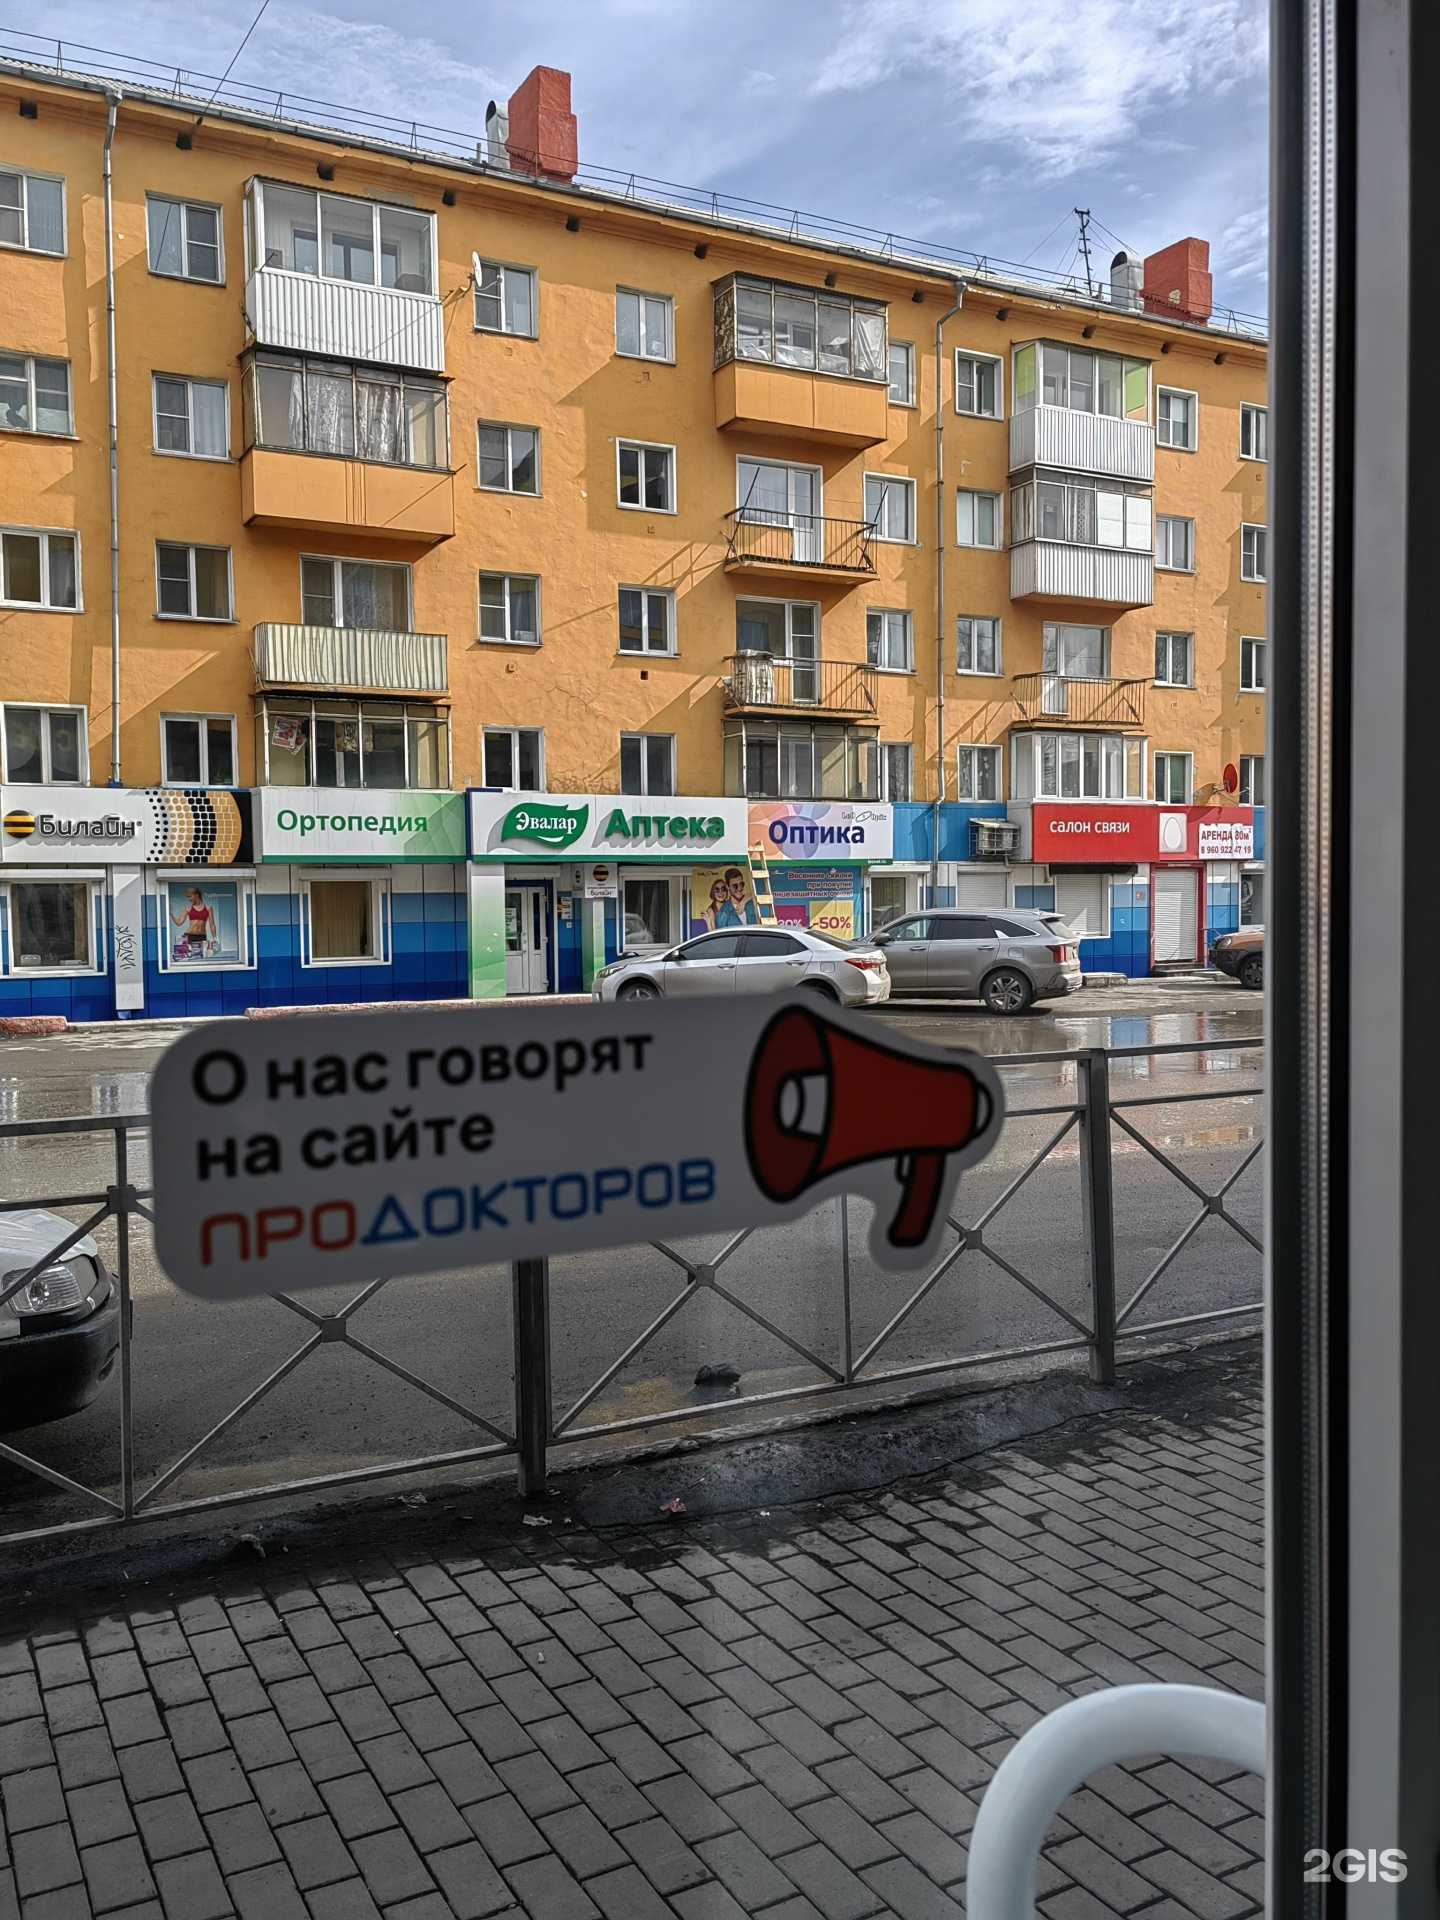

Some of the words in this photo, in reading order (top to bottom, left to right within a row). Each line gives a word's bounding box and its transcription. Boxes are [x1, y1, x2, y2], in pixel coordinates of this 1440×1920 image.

[39, 814, 136, 837] Билайн
[277, 809, 428, 837] Ортопедия
[515, 811, 578, 834] Эвалар
[604, 808, 726, 839] Аптека
[768, 820, 865, 845] Оптика
[1049, 820, 1091, 833] салон
[1094, 821, 1131, 834] связи
[1201, 830, 1234, 842] АРЕНДА
[192, 1049, 248, 1104] О
[267, 1048, 390, 1101] нас
[406, 1033, 655, 1092] говорят
[195, 1131, 282, 1182] на
[300, 1106, 496, 1170] сайте
[200, 1158, 717, 1267] ПРОДОКТОРОВ
